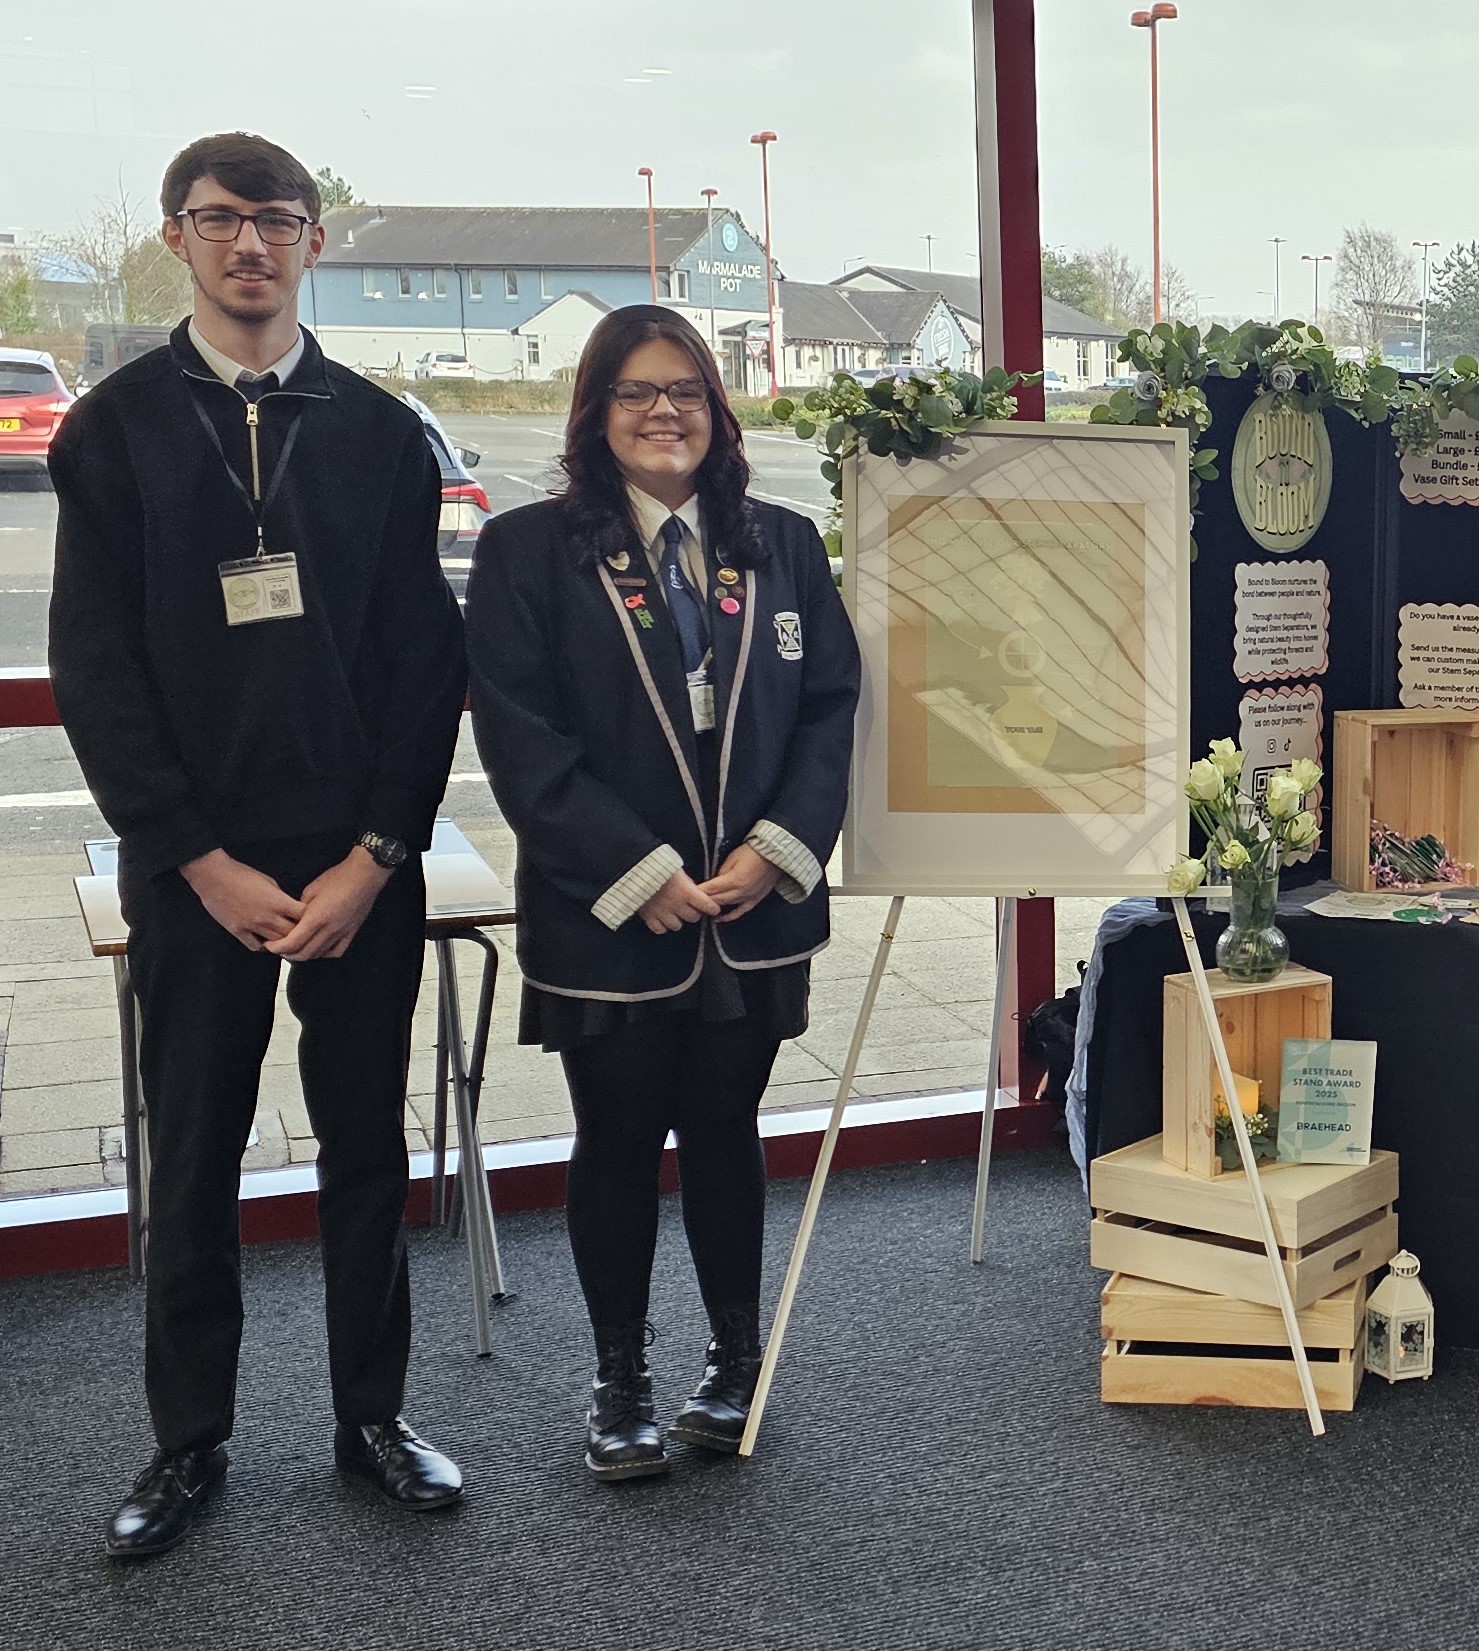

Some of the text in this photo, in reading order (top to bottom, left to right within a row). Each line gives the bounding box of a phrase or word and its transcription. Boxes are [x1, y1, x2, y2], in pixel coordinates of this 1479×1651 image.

[720, 278, 741, 292] POT
[1254, 411, 1314, 468] BOUND
[1438, 430, 1466, 441] Small
[1436, 444, 1465, 457] Large
[1431, 459, 1468, 471] Bundle
[1413, 474, 1437, 484] Vase
[1440, 475, 1459, 486] Gift
[1254, 475, 1315, 536] BLOOM
[1271, 578, 1287, 586] Bloom
[1278, 590, 1295, 598] people
[1269, 624, 1281, 632] Stem
[1411, 644, 1430, 652] Send
[1442, 667, 1462, 675] Stem
[1248, 702, 1314, 714] Please follow along with
[1325, 1068, 1353, 1077] TRADE
[1293, 1078, 1361, 1088] STAND AWARD
[1296, 1122, 1351, 1132] BRAEHEAD
